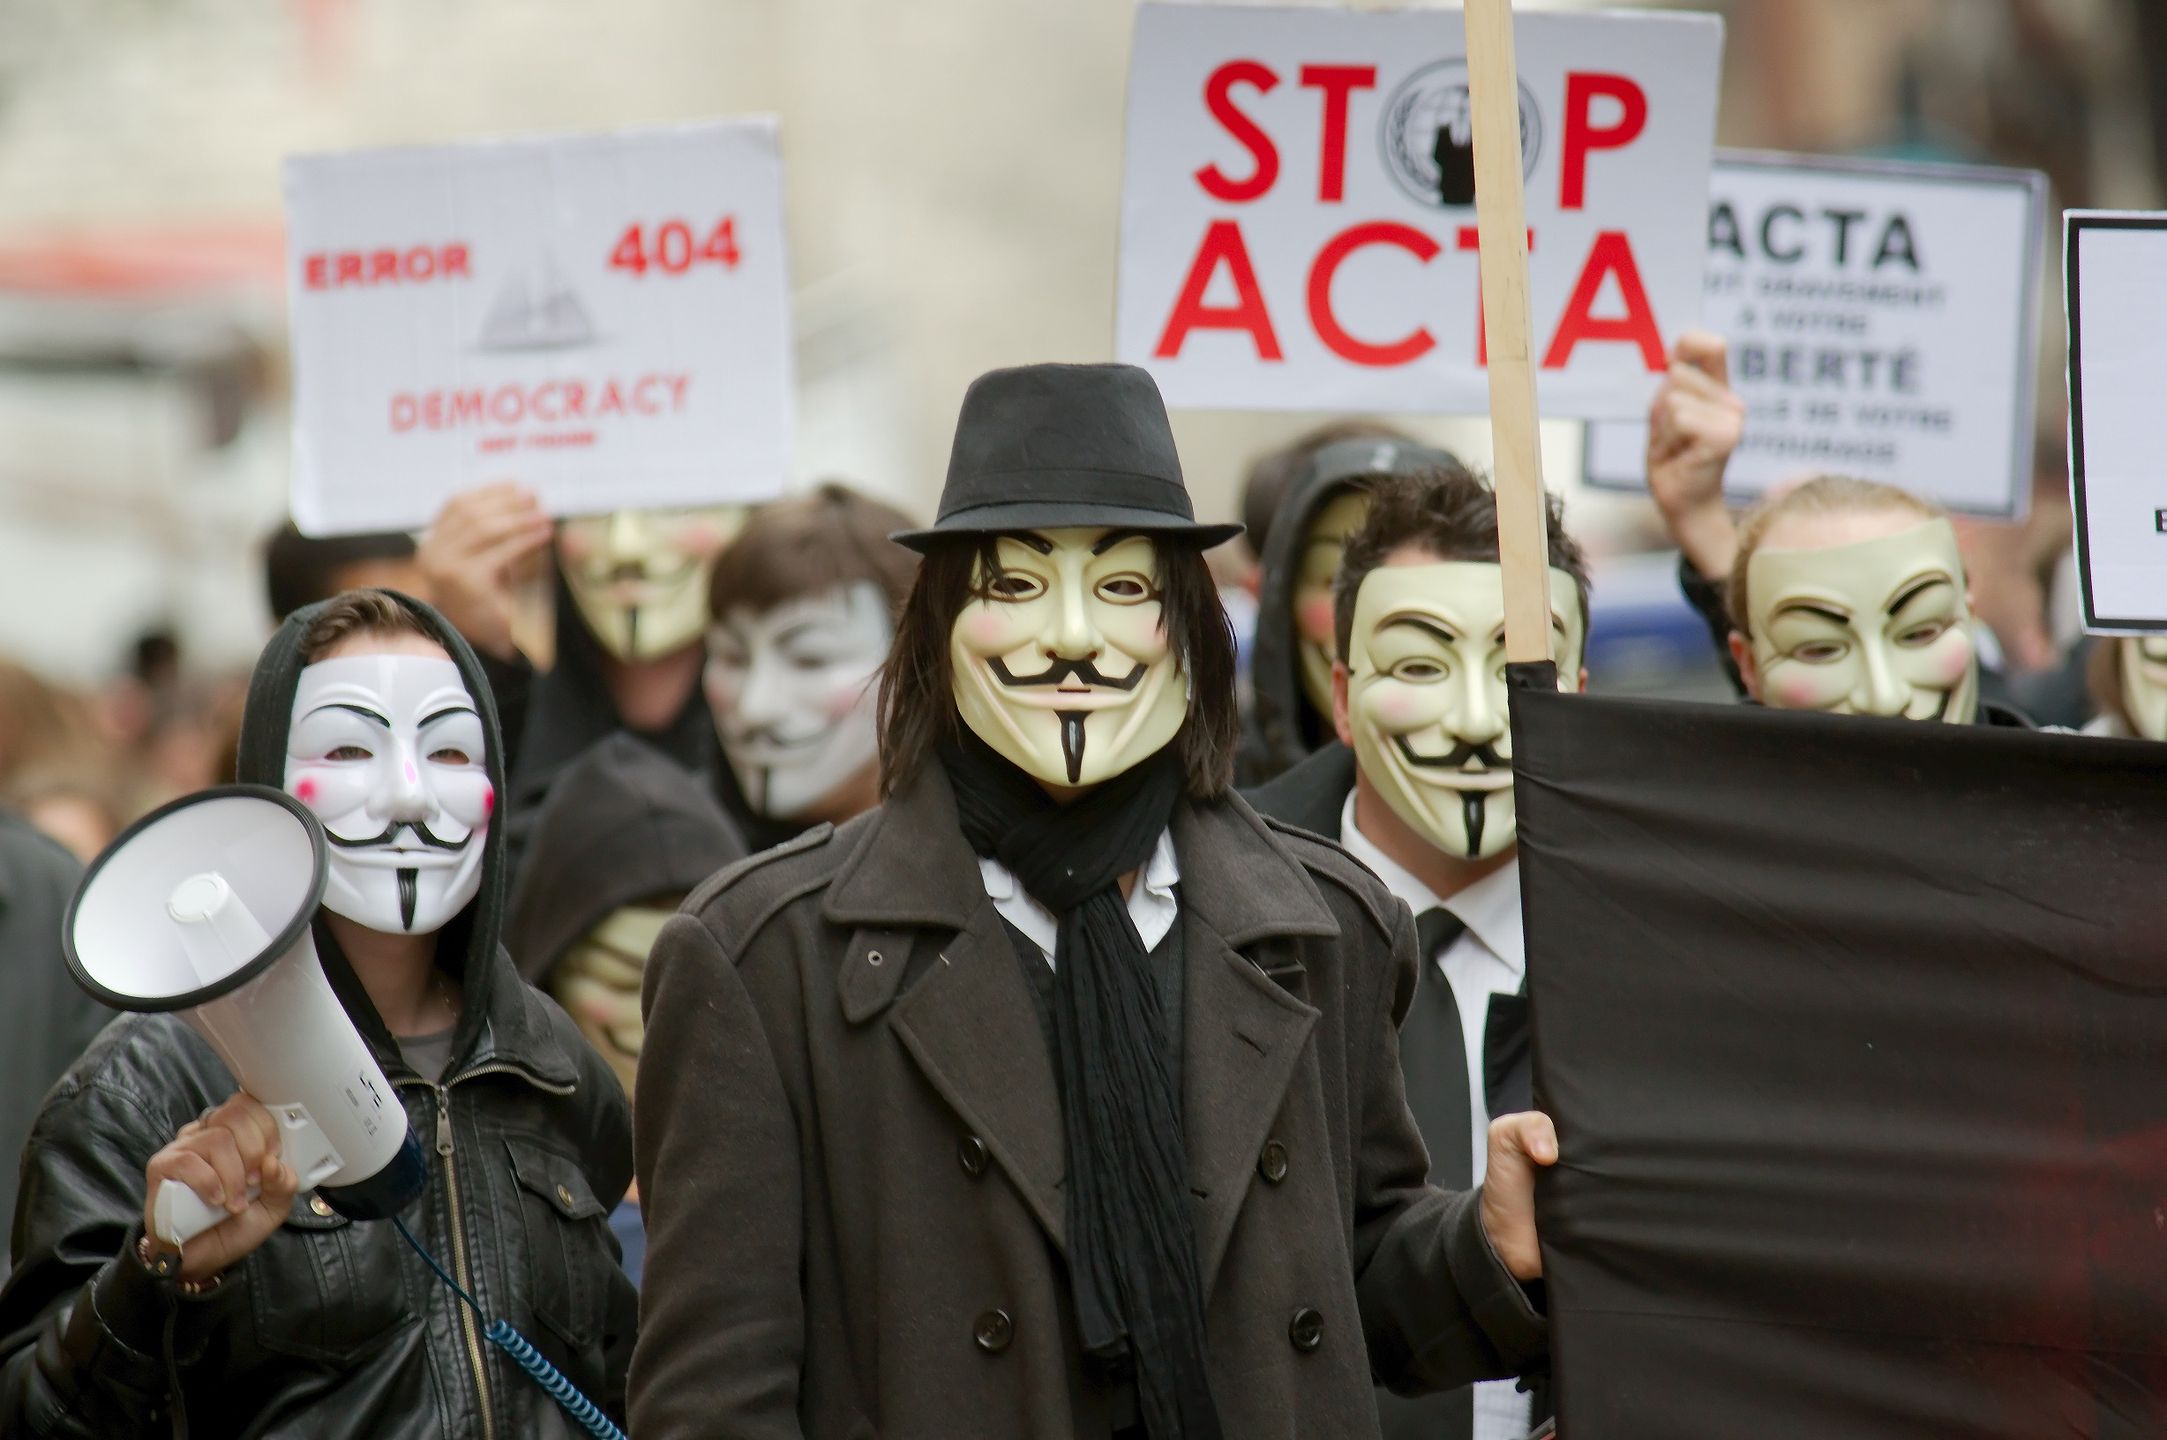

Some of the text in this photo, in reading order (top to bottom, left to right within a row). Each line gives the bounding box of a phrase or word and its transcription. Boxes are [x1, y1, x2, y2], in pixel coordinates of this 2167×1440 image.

[304, 215, 740, 290] ERROR 404
[1706, 203, 1918, 272] ACTA
[1740, 346, 1919, 392] BERTÉ
[389, 374, 689, 432] DEMOCRACY
